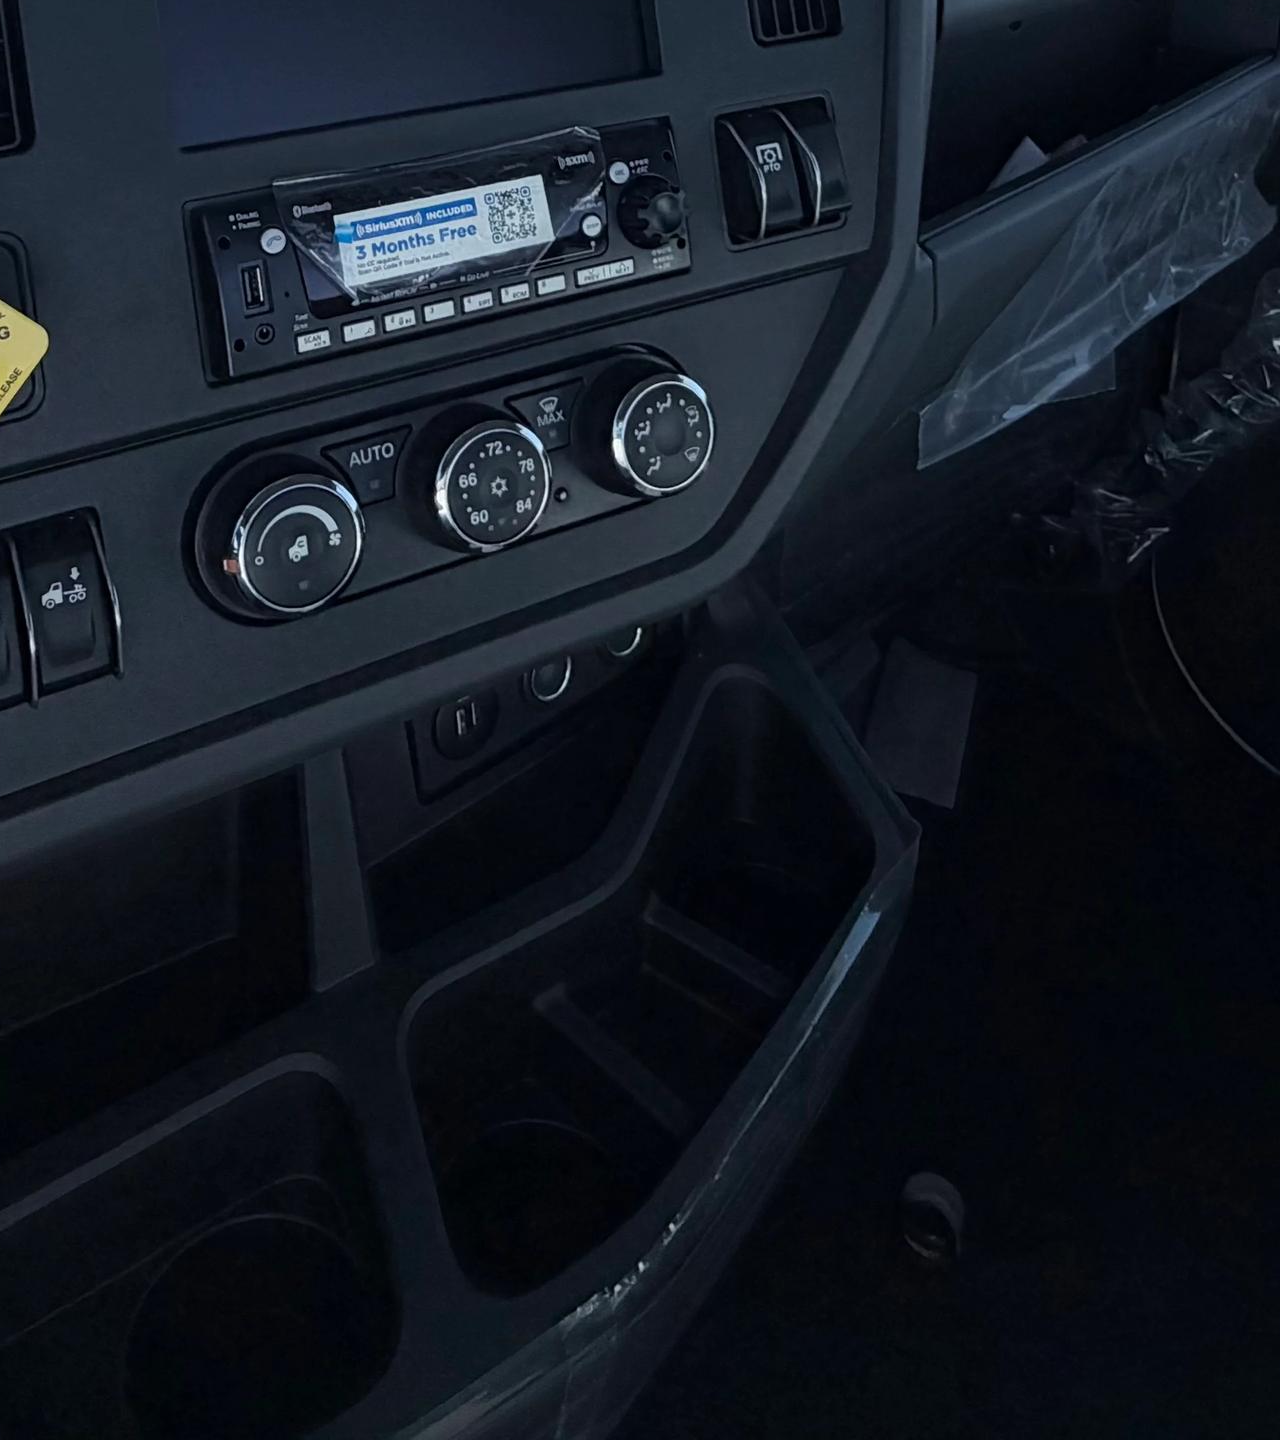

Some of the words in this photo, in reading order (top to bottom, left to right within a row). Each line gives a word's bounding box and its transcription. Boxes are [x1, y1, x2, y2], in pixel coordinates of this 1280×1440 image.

[763, 162, 781, 173] PTO
[425, 203, 474, 221] INCLUDED
[355, 244, 367, 260] 3
[371, 231, 435, 257] Months
[438, 224, 477, 242] Free
[536, 409, 565, 426] MAX
[348, 442, 395, 468] AUTO
[485, 440, 504, 457] 72
[518, 457, 535, 474] 78
[458, 472, 478, 489] 66
[515, 497, 532, 514] 84
[470, 509, 489, 526] 60
